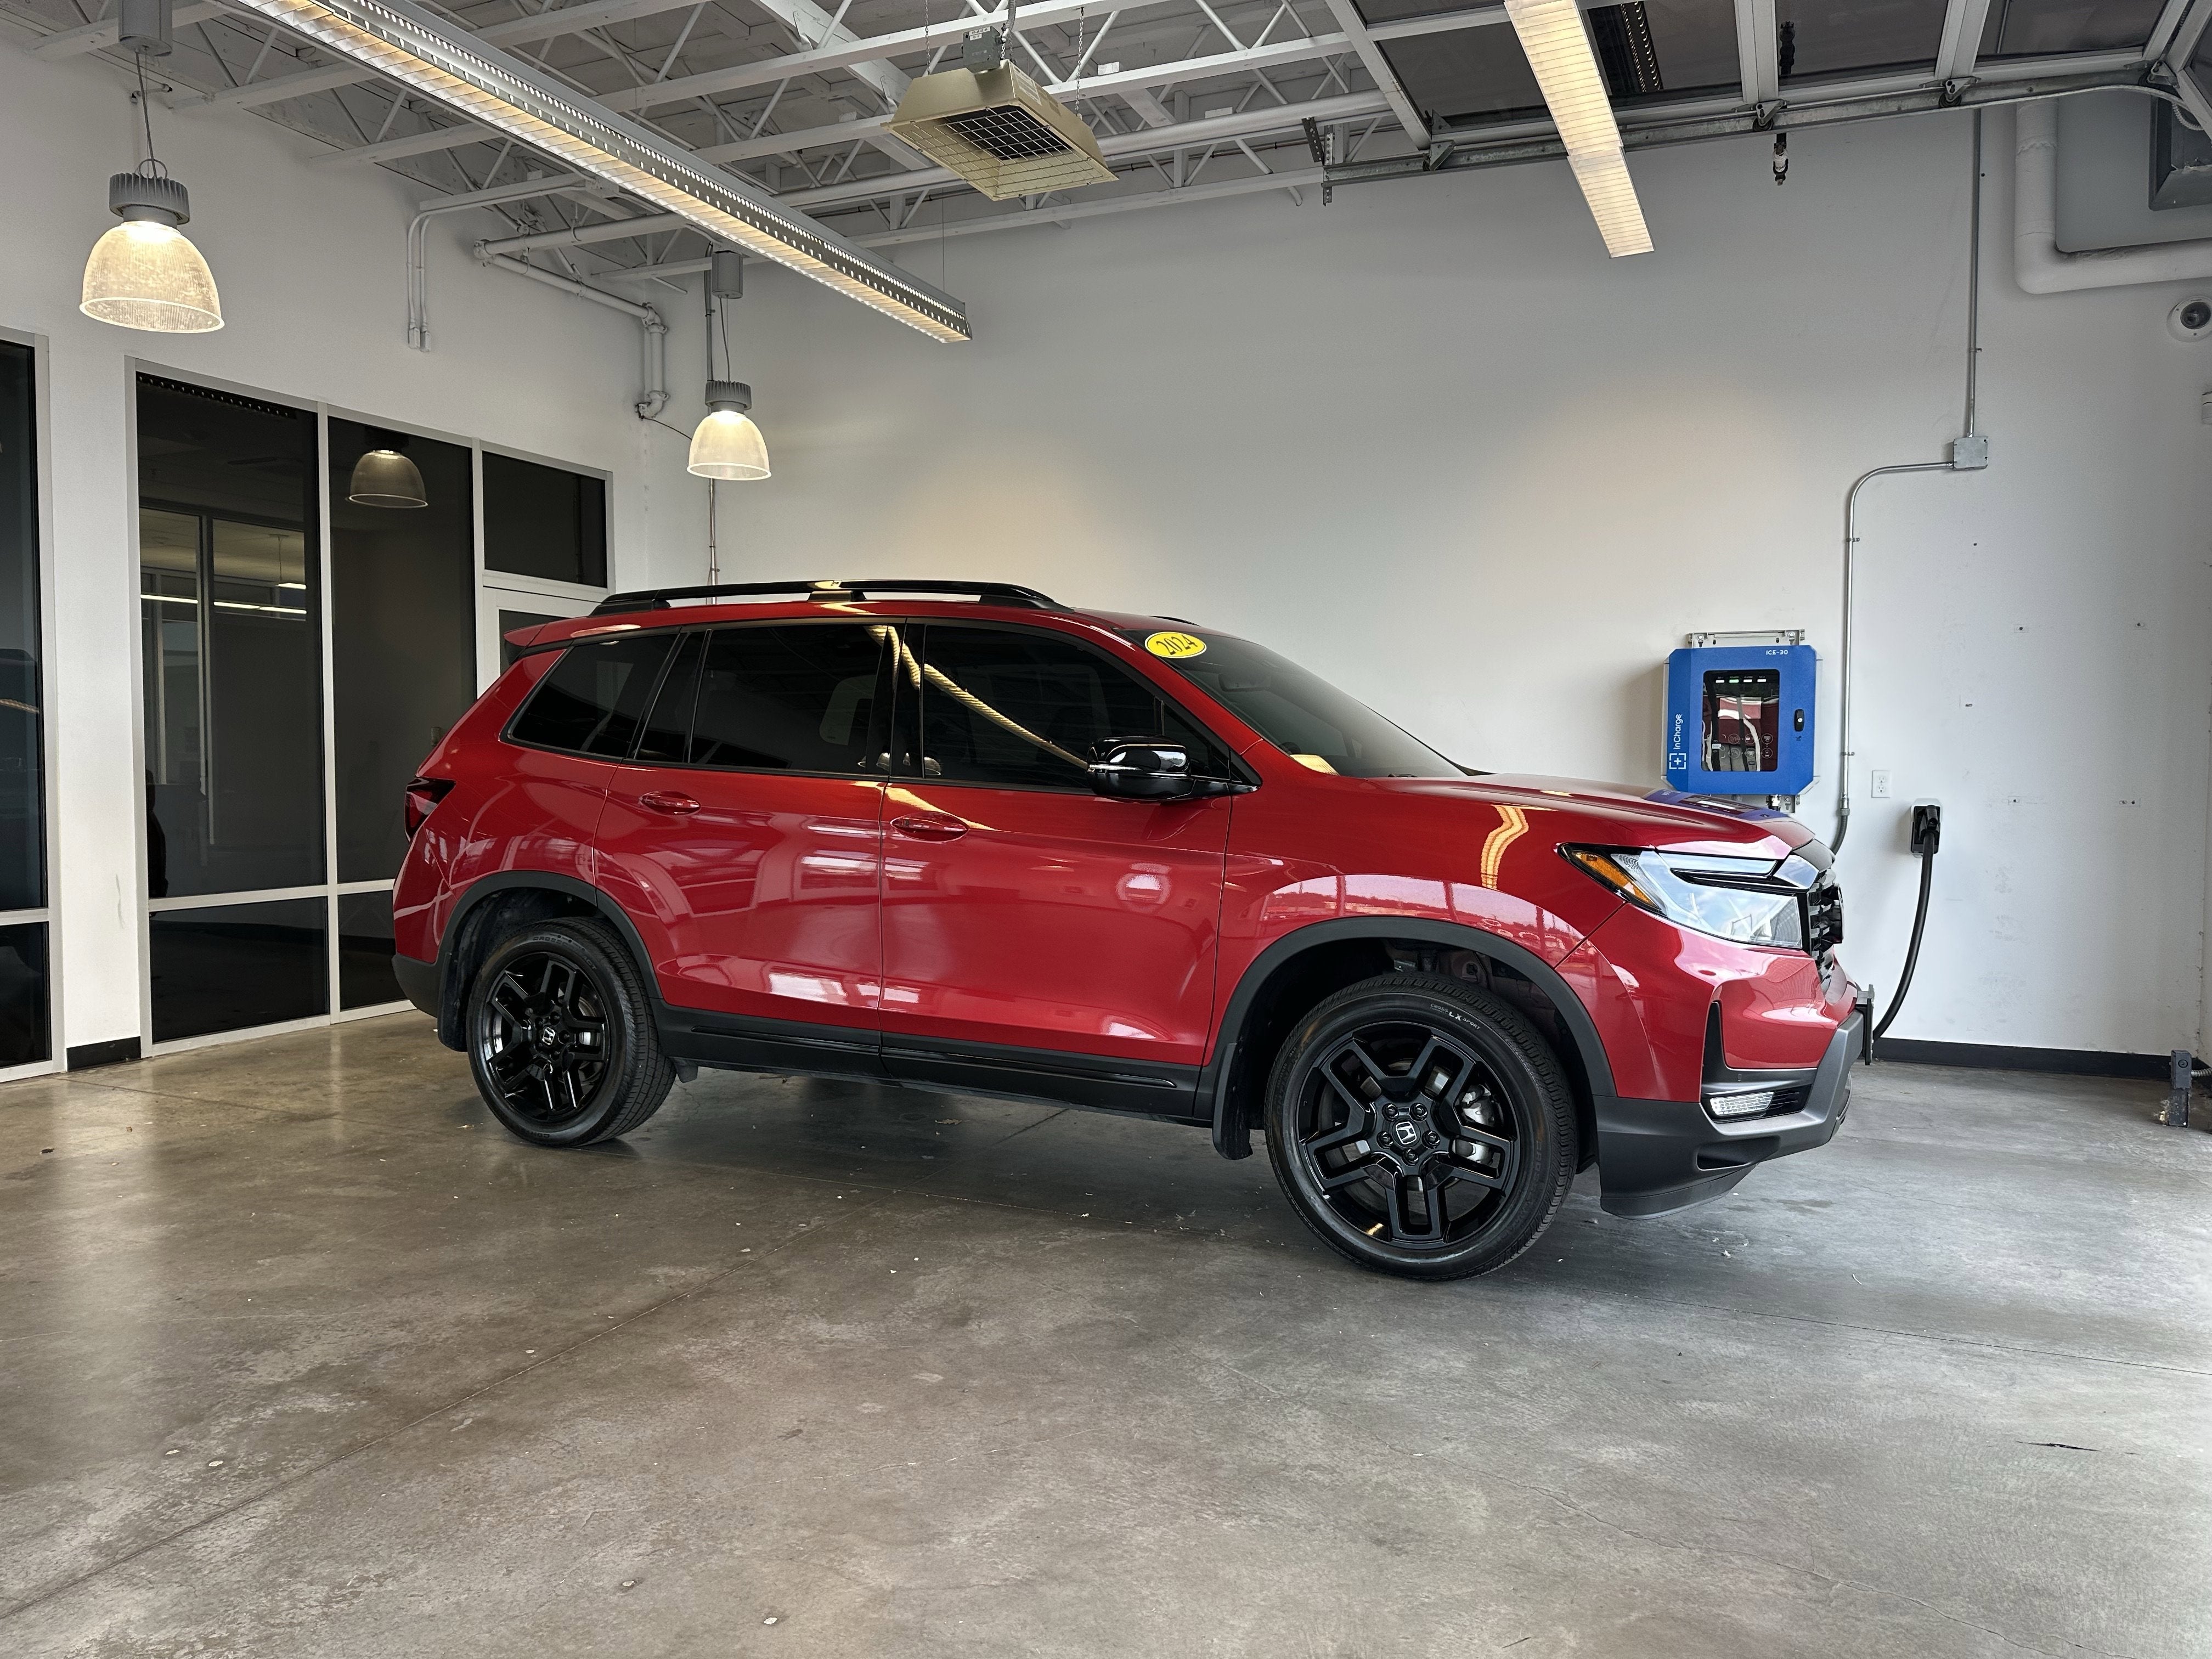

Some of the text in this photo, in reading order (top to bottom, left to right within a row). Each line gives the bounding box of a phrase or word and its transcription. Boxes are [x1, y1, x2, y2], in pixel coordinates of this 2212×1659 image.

[1155, 634, 1198, 656] 2024
[1673, 714, 1684, 750] InCharge
[1448, 1011, 1462, 1021] LX
[1462, 1017, 1481, 1030] SPORT
